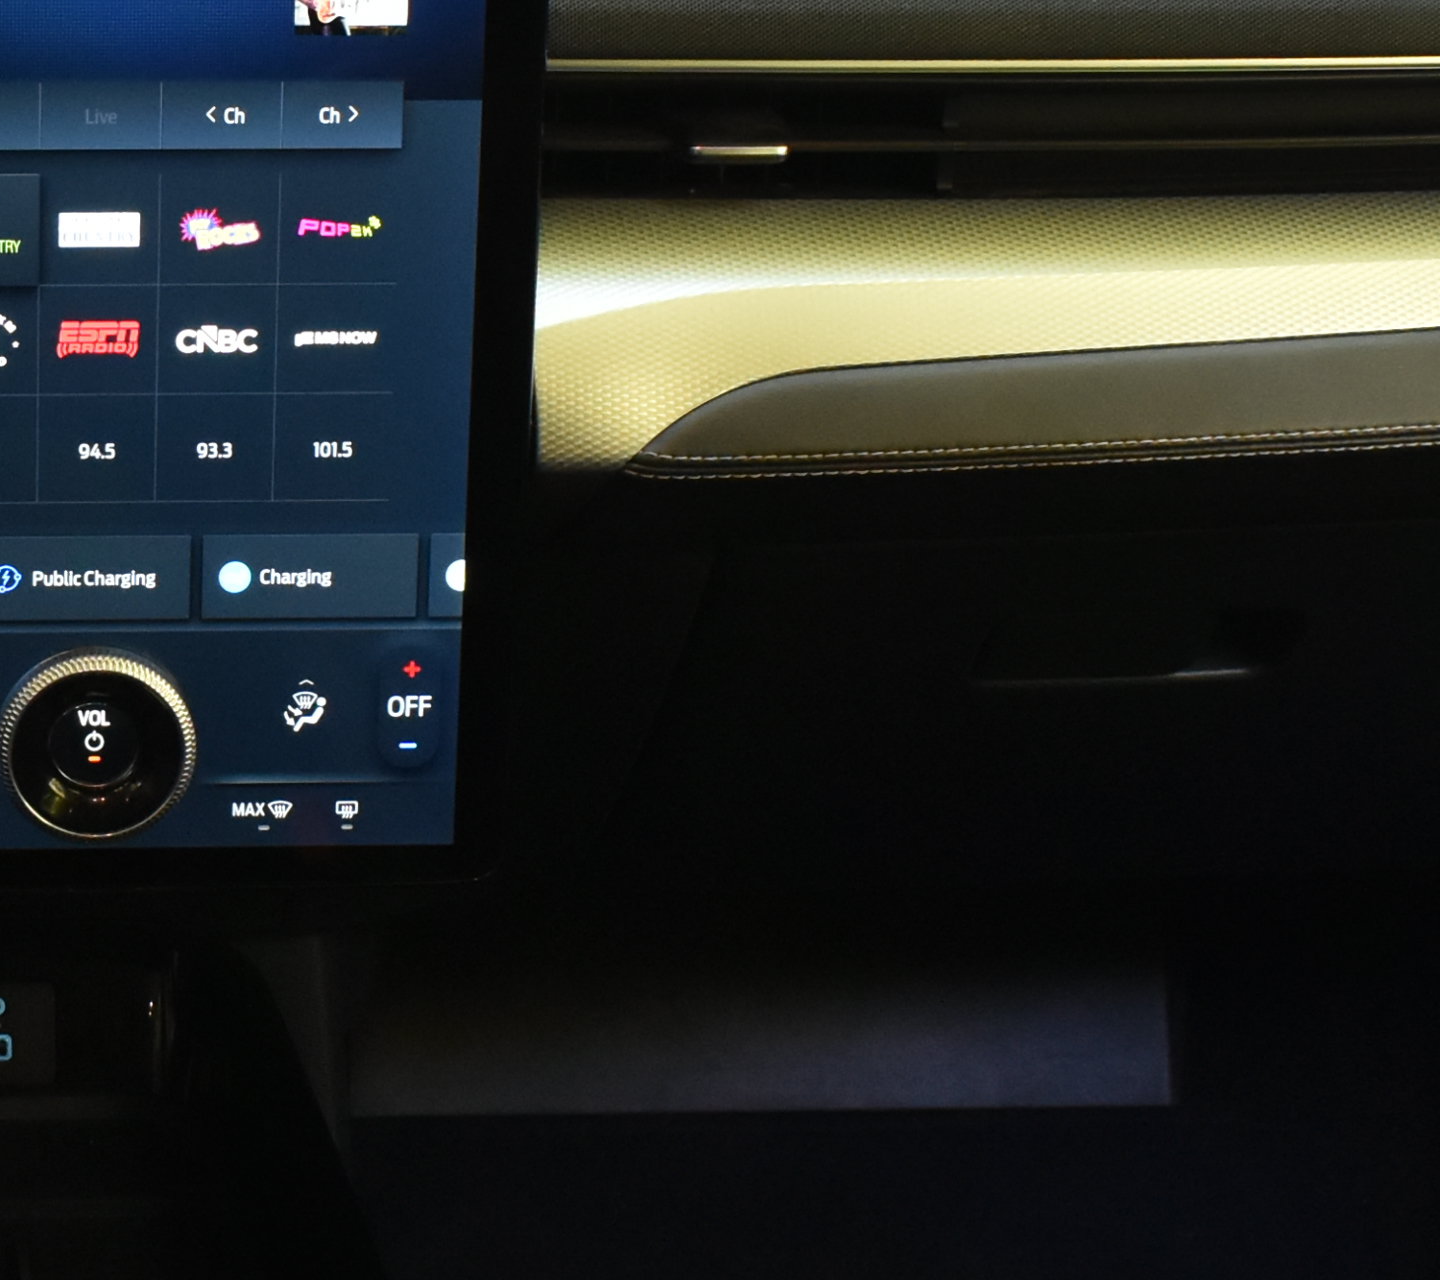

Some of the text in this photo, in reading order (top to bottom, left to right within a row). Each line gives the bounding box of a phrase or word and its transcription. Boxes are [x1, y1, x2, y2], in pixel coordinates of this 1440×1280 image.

[85, 108, 118, 124] Live
[224, 107, 245, 124] Ch
[319, 106, 341, 124] Ch
[60, 320, 140, 343] ESPN
[175, 325, 258, 354] CNBC
[339, 331, 378, 345] NOW
[68, 343, 129, 355] RADIO
[78, 444, 116, 461] 94.5
[196, 442, 233, 460] 93.3
[312, 441, 353, 459] 101.5
[32, 569, 156, 589] Public Charging
[259, 567, 332, 587] Charging
[387, 696, 432, 718] OFF
[78, 710, 110, 727] VOL
[232, 802, 264, 818] MAX
